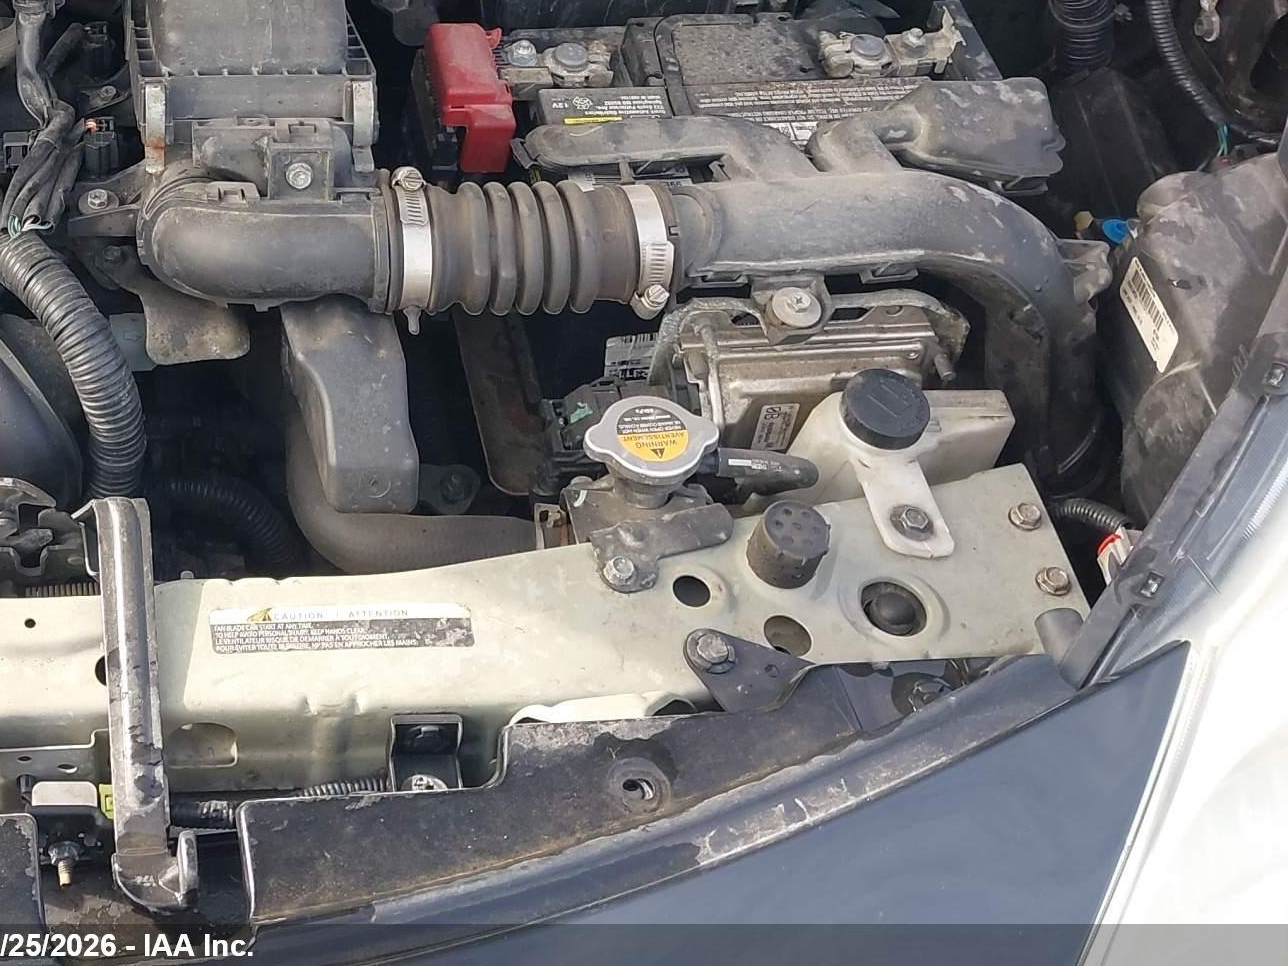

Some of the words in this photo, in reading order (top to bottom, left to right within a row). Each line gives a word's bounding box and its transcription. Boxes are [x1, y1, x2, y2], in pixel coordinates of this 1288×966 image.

[623, 432, 684, 441] AVERTISSEMENT
[635, 440, 677, 449] WARNING
[274, 612, 323, 620] CAUTION
